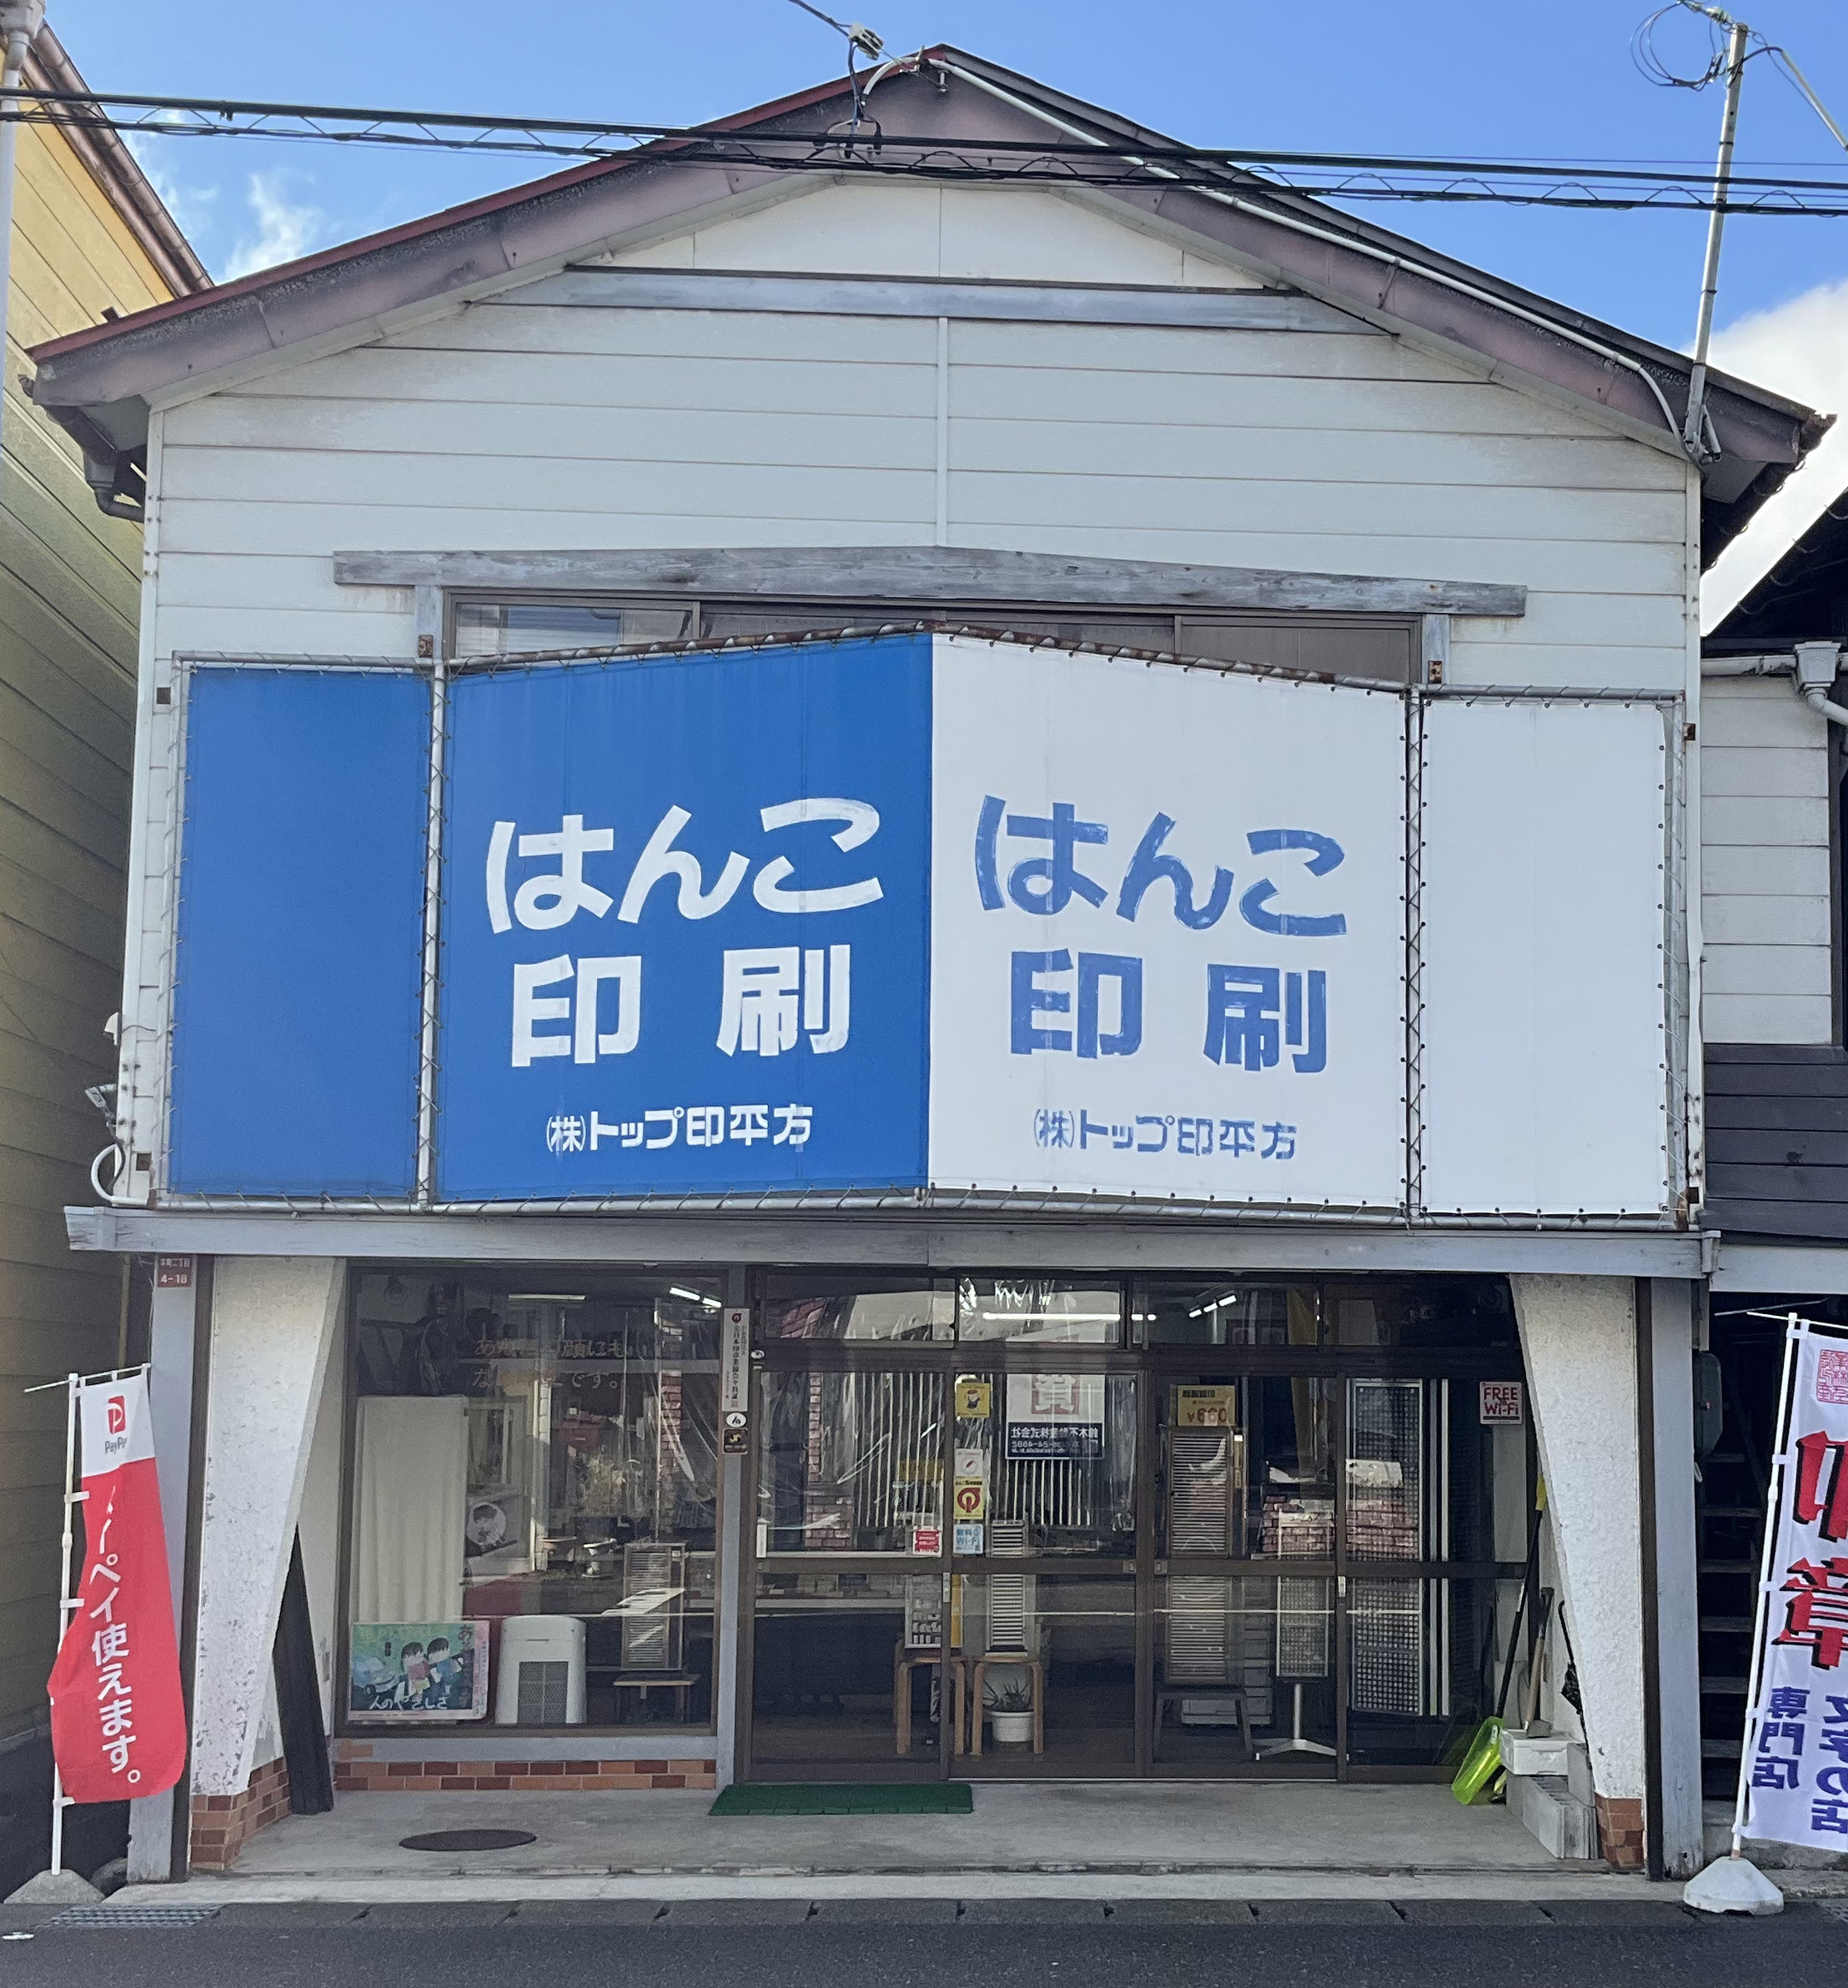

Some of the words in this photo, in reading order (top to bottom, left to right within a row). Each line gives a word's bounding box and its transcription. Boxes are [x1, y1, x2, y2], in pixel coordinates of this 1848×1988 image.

[486, 797, 883, 934] はんこ
[975, 795, 1346, 936] はんこ
[161, 1273, 188, 1284] 4-18
[1484, 1387, 1518, 1400] FREE
[1484, 1402, 1519, 1415] Wi-Fi
